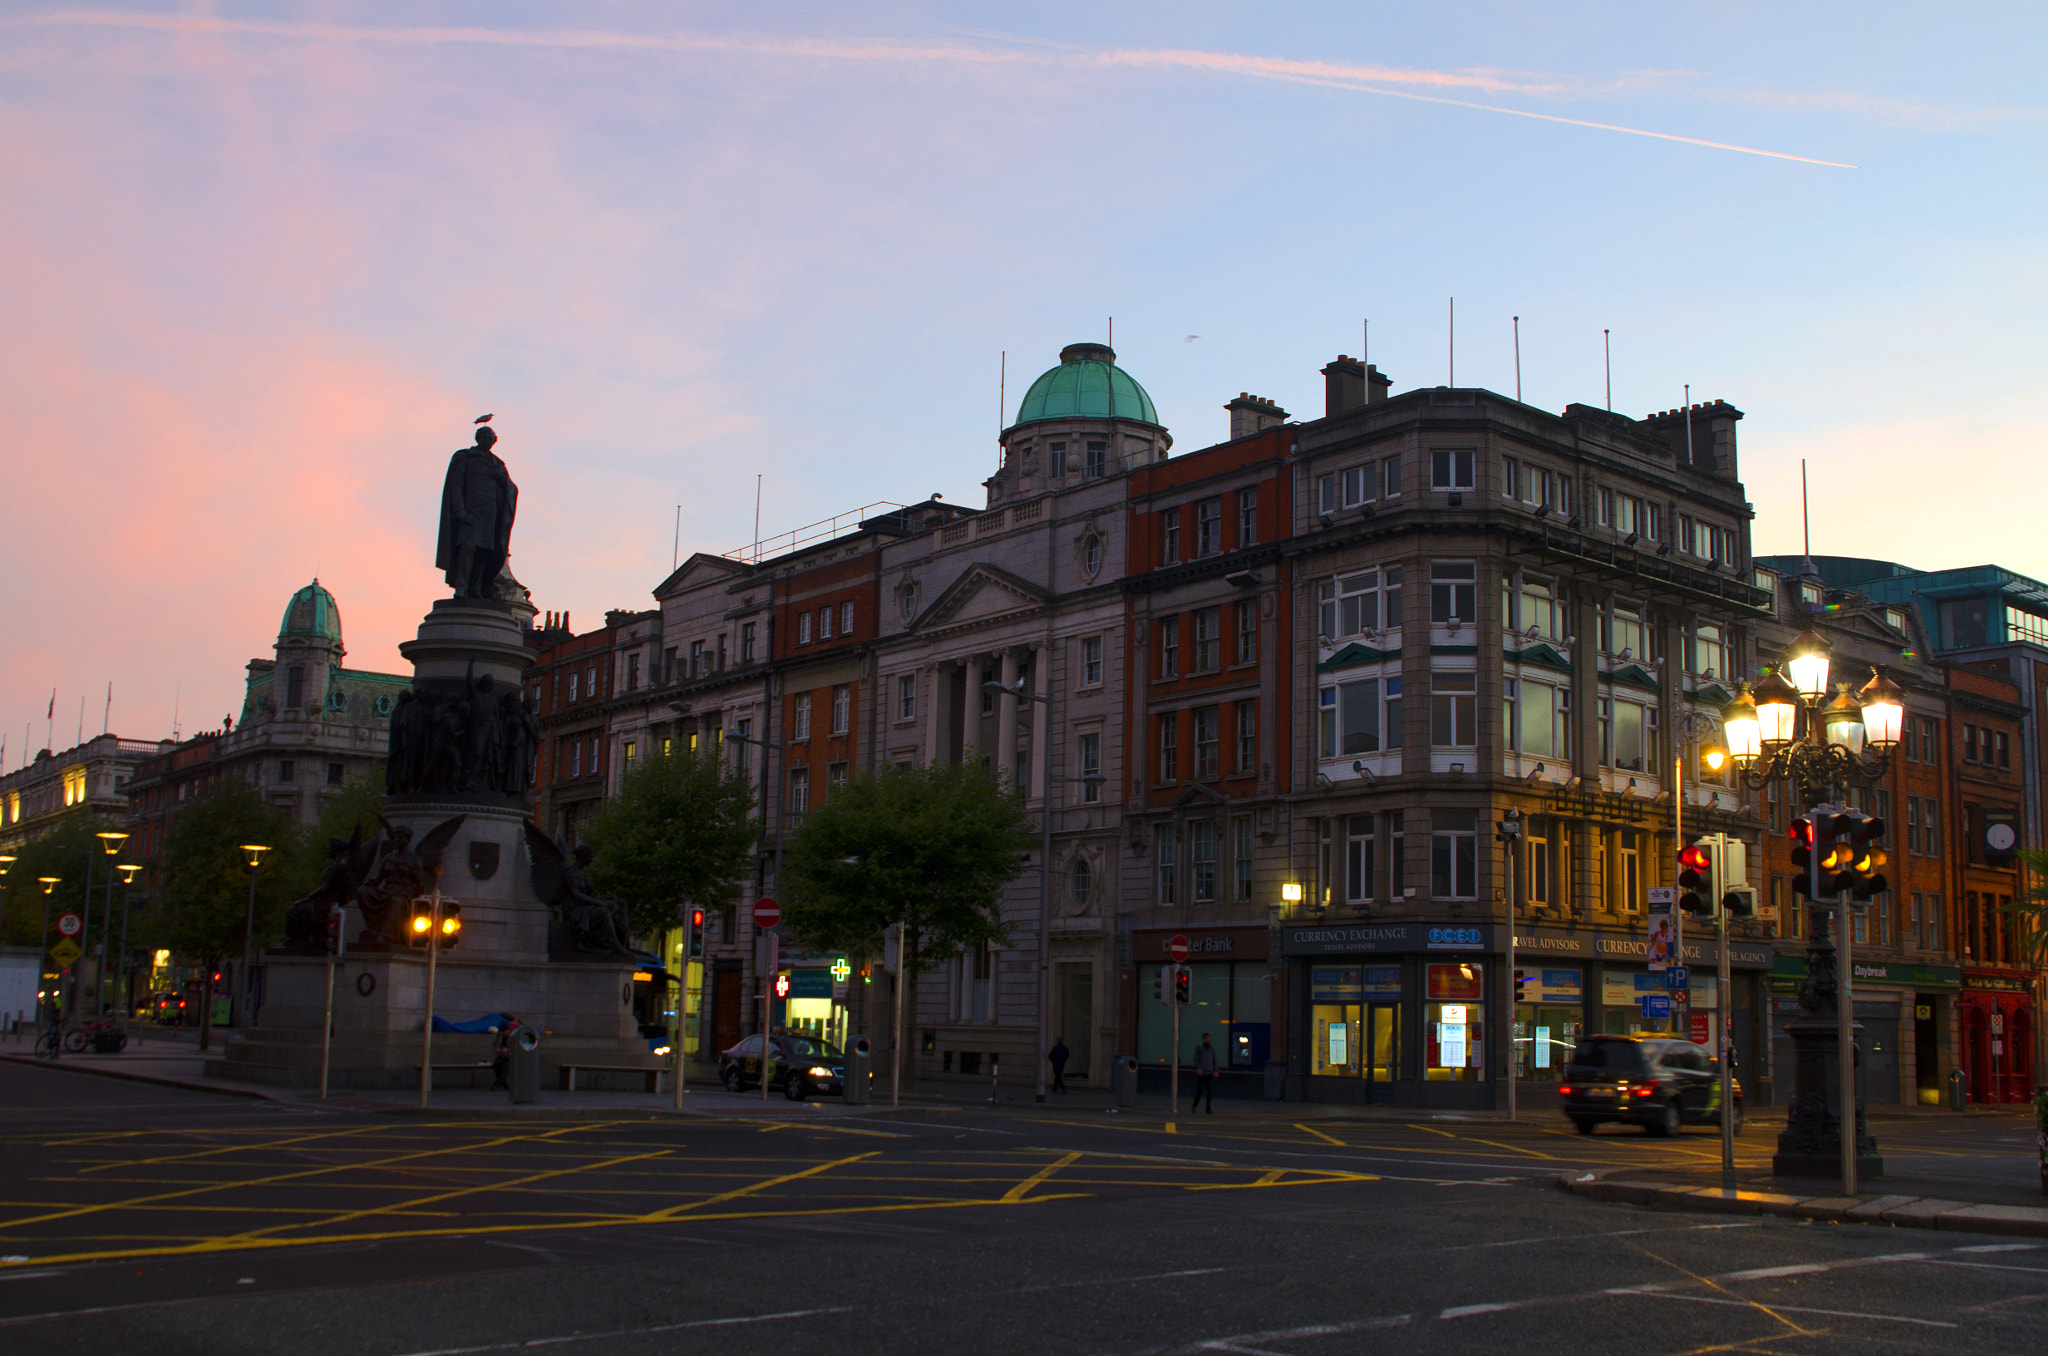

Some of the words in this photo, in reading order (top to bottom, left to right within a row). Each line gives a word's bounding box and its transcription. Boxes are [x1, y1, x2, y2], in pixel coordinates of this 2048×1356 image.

[1294, 930, 1349, 943] CURRENCY
[1351, 928, 1408, 941] EXCHANGE
[1431, 929, 1479, 942] FCEI
[1206, 937, 1233, 952] Bank
[1512, 936, 1538, 948] RAVEL
[1540, 938, 1580, 951] ADVISORS
[1596, 940, 1649, 955] CURRENCY
[1740, 952, 1766, 963] AGENCY
[1676, 969, 1687, 986] P
[1855, 965, 1887, 978] Daybreak
